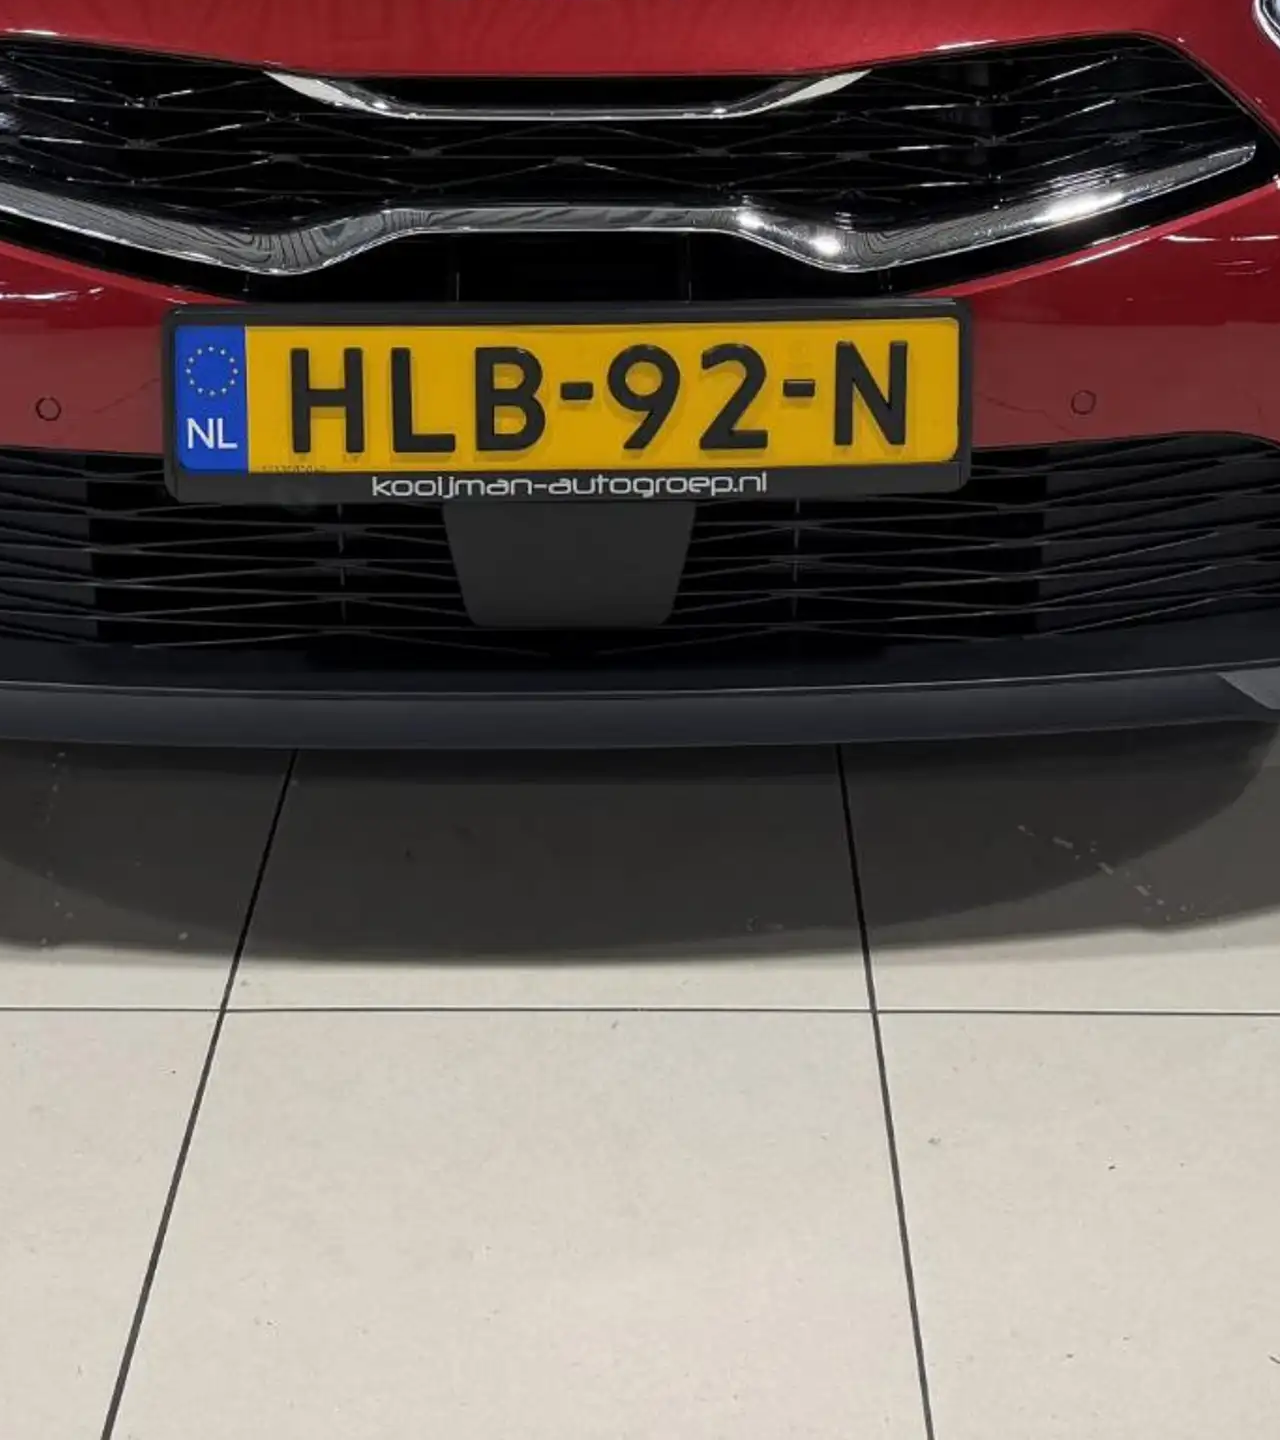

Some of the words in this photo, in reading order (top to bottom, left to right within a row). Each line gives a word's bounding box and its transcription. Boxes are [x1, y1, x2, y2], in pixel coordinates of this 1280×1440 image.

[289, 340, 909, 454] HLB-92-N
[186, 417, 238, 450] NL
[371, 471, 768, 498] kooijman-autogroep.nl
